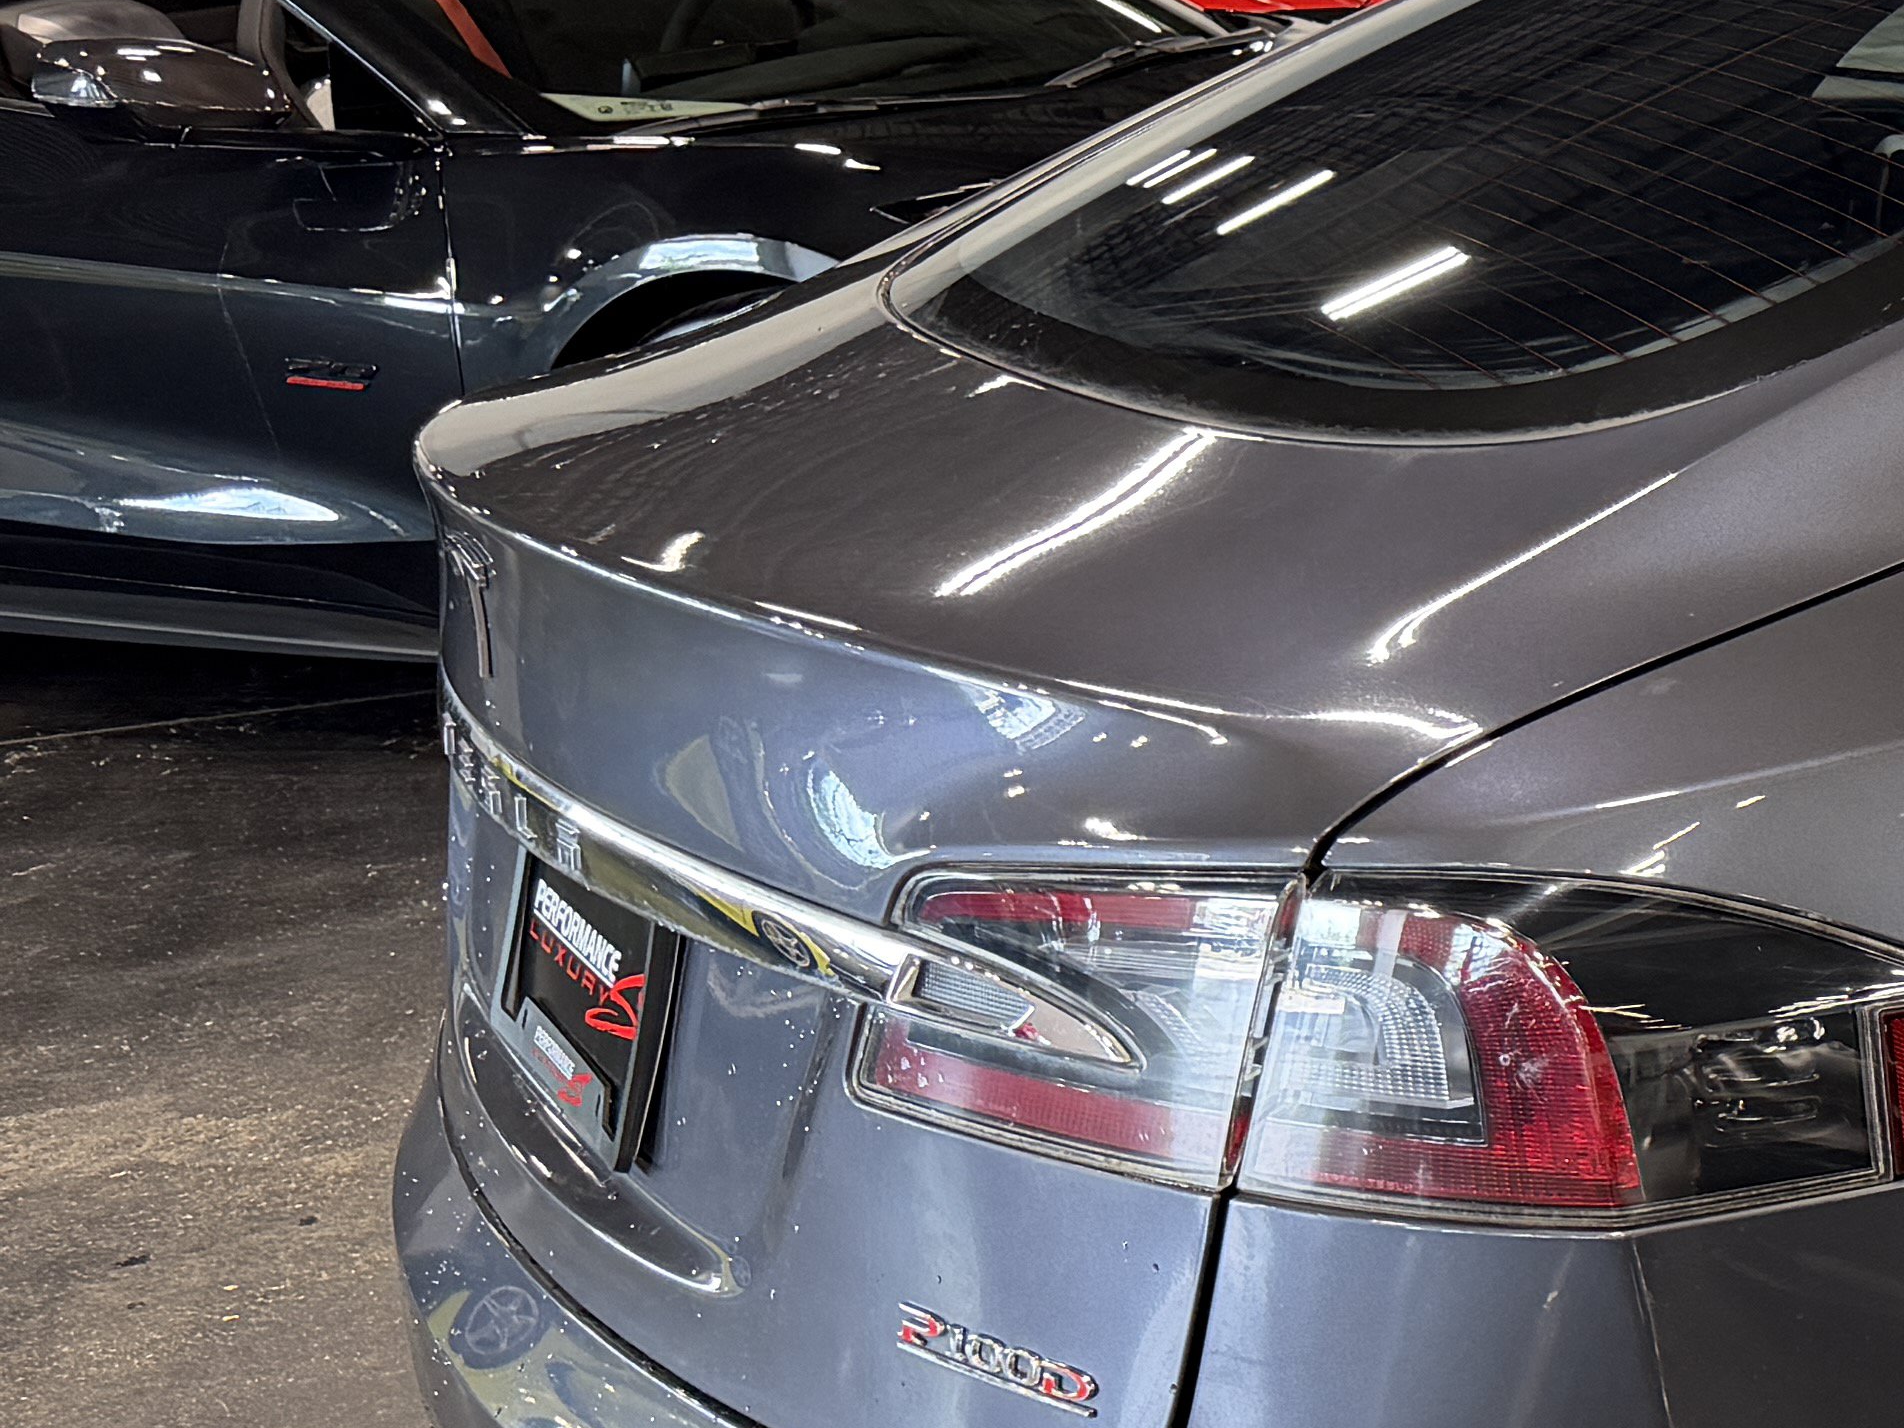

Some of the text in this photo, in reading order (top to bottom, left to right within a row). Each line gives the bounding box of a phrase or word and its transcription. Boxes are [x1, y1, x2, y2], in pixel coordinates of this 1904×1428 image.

[443, 713, 582, 872] TESLA
[529, 919, 611, 1004] LUXURY
[533, 878, 622, 982] PERFORMANCE
[898, 1301, 1099, 1401] P100D
